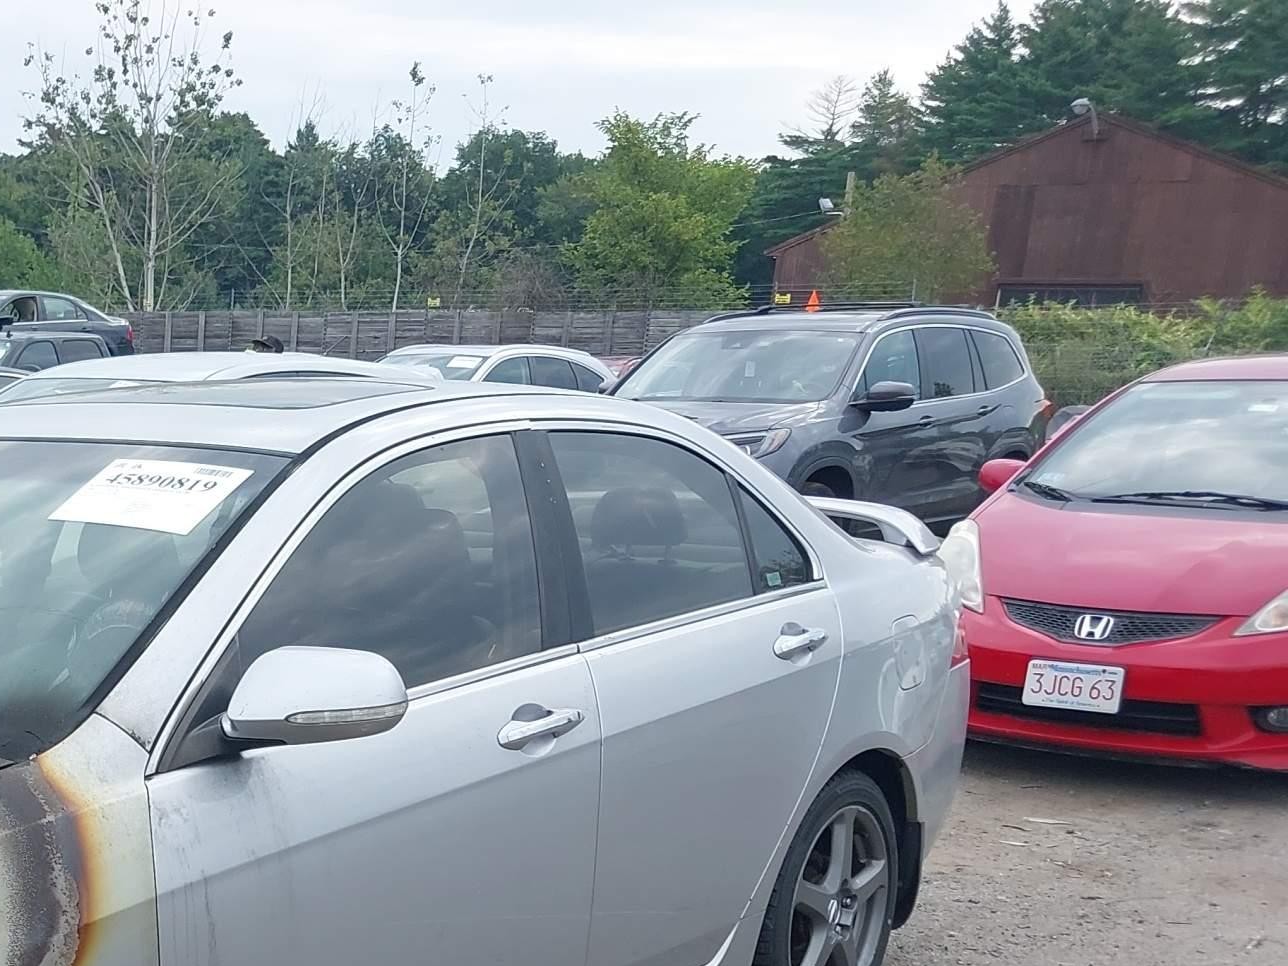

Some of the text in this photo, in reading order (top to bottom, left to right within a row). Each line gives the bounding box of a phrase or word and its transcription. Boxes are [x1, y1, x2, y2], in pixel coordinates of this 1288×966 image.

[106, 472, 218, 492] 45890819
[1030, 673, 1117, 700] 3JCG 63
